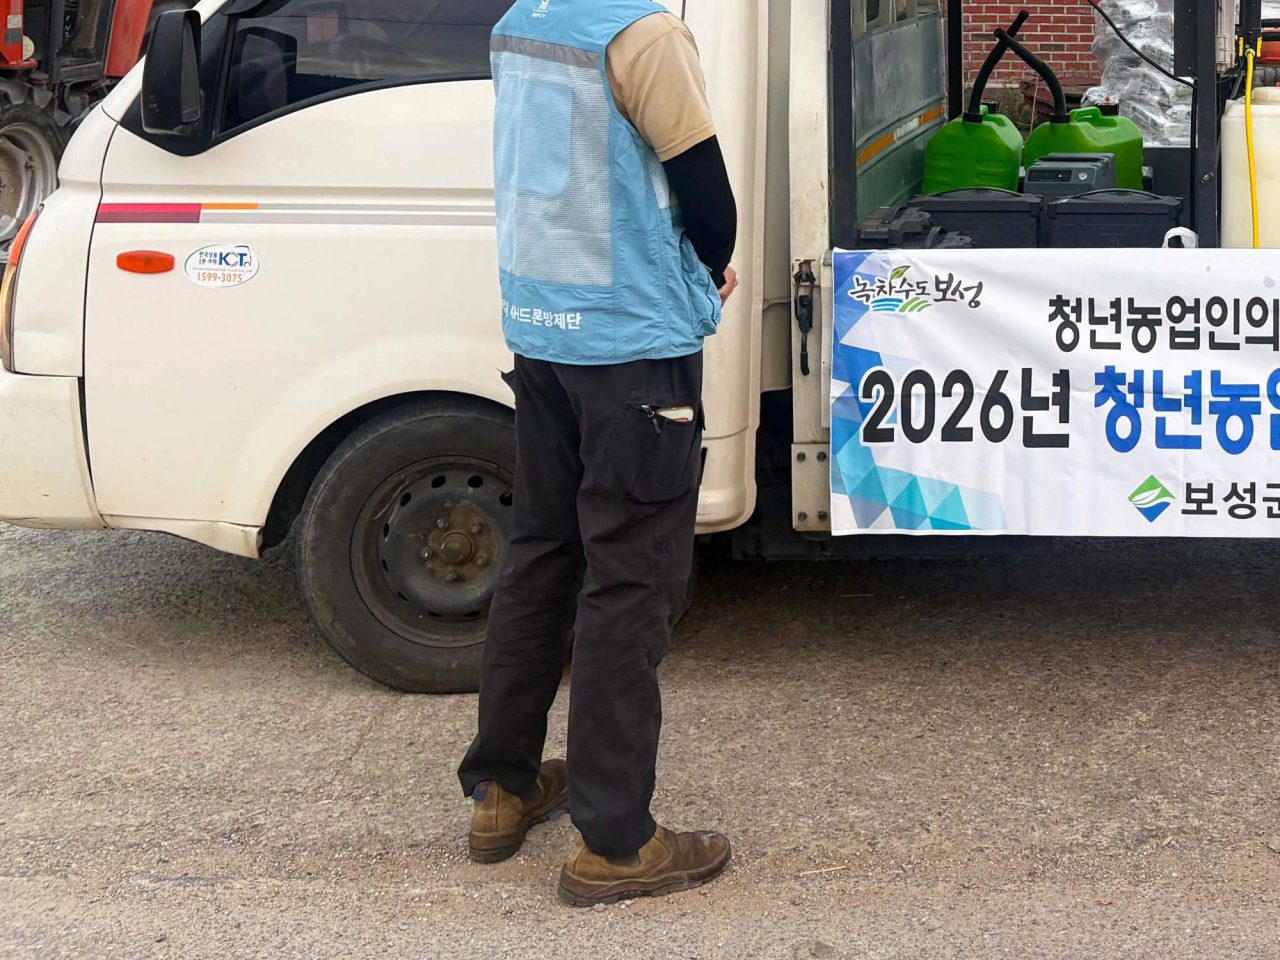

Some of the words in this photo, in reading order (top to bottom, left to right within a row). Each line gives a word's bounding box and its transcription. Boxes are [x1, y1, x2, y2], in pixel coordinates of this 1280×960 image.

[219, 252, 247, 267] KCT
[850, 276, 931, 303] 녹차수도
[933, 272, 983, 308] 보성
[1049, 295, 1279, 353] 청년농업인의
[861, 367, 1071, 450] 2026년
